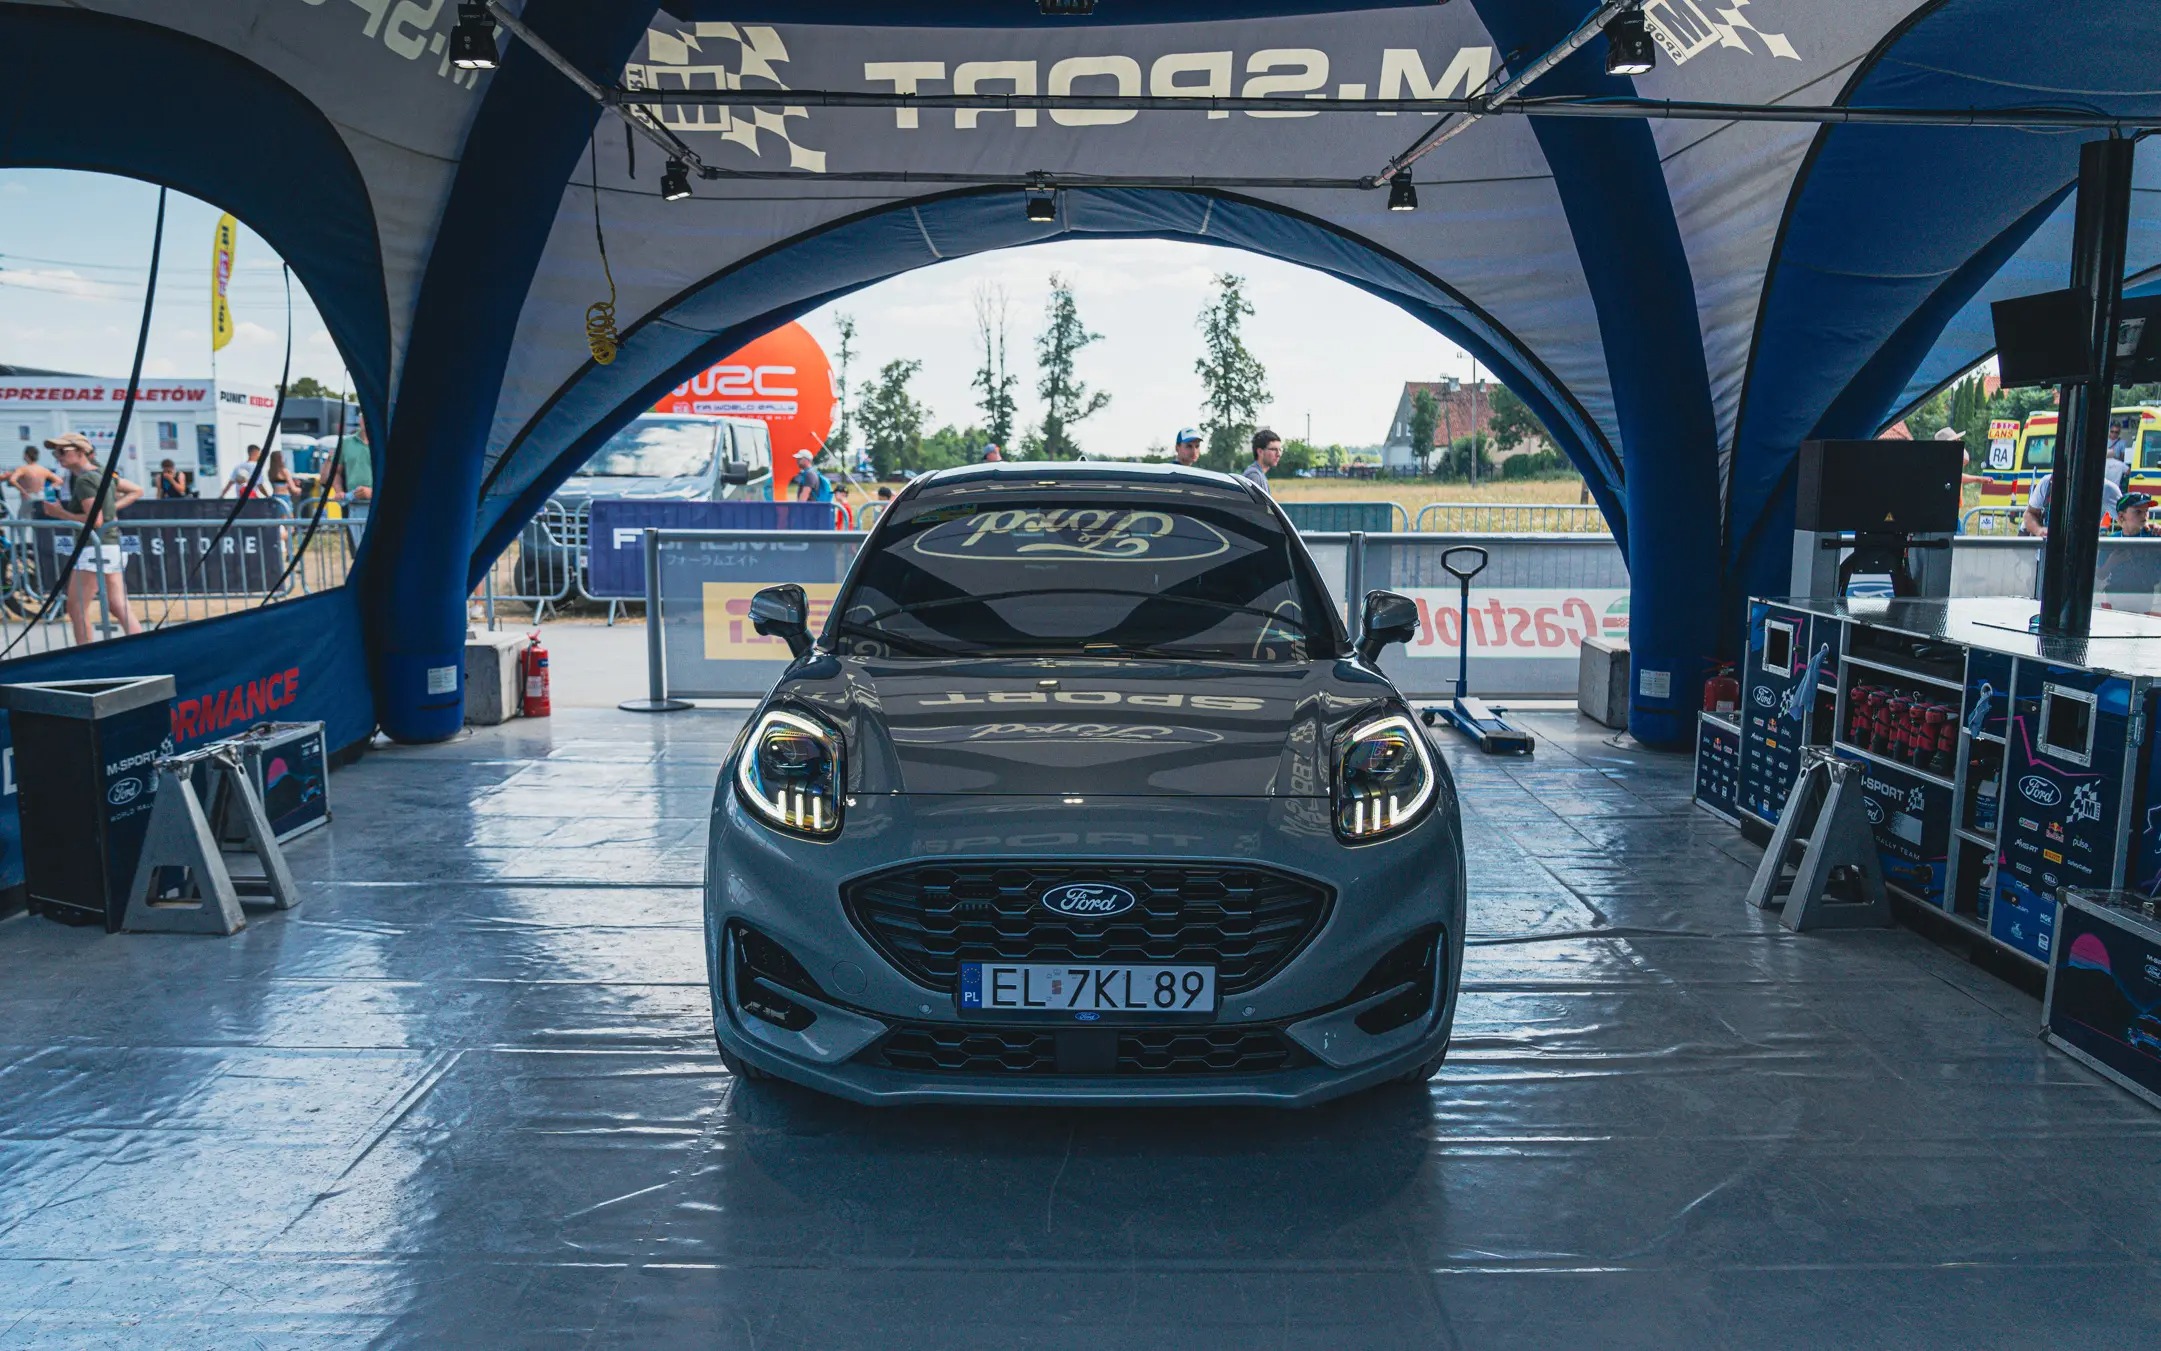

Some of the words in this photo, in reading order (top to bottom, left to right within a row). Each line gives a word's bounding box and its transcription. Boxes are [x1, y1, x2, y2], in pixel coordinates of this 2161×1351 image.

[112, 385, 207, 401] BLETÓW
[1993, 448, 2008, 462] RA
[151, 536, 257, 555] STORE
[106, 749, 157, 776] M-SPORT
[113, 781, 137, 802] Ford
[1861, 775, 1905, 802] -SPORT
[2024, 777, 2054, 803] Ford
[1900, 846, 1920, 861] TEAM
[1060, 887, 1118, 911] Ford
[964, 991, 979, 1002] PL
[992, 968, 1046, 1006] EL
[1067, 969, 1205, 1009] 7KL89
